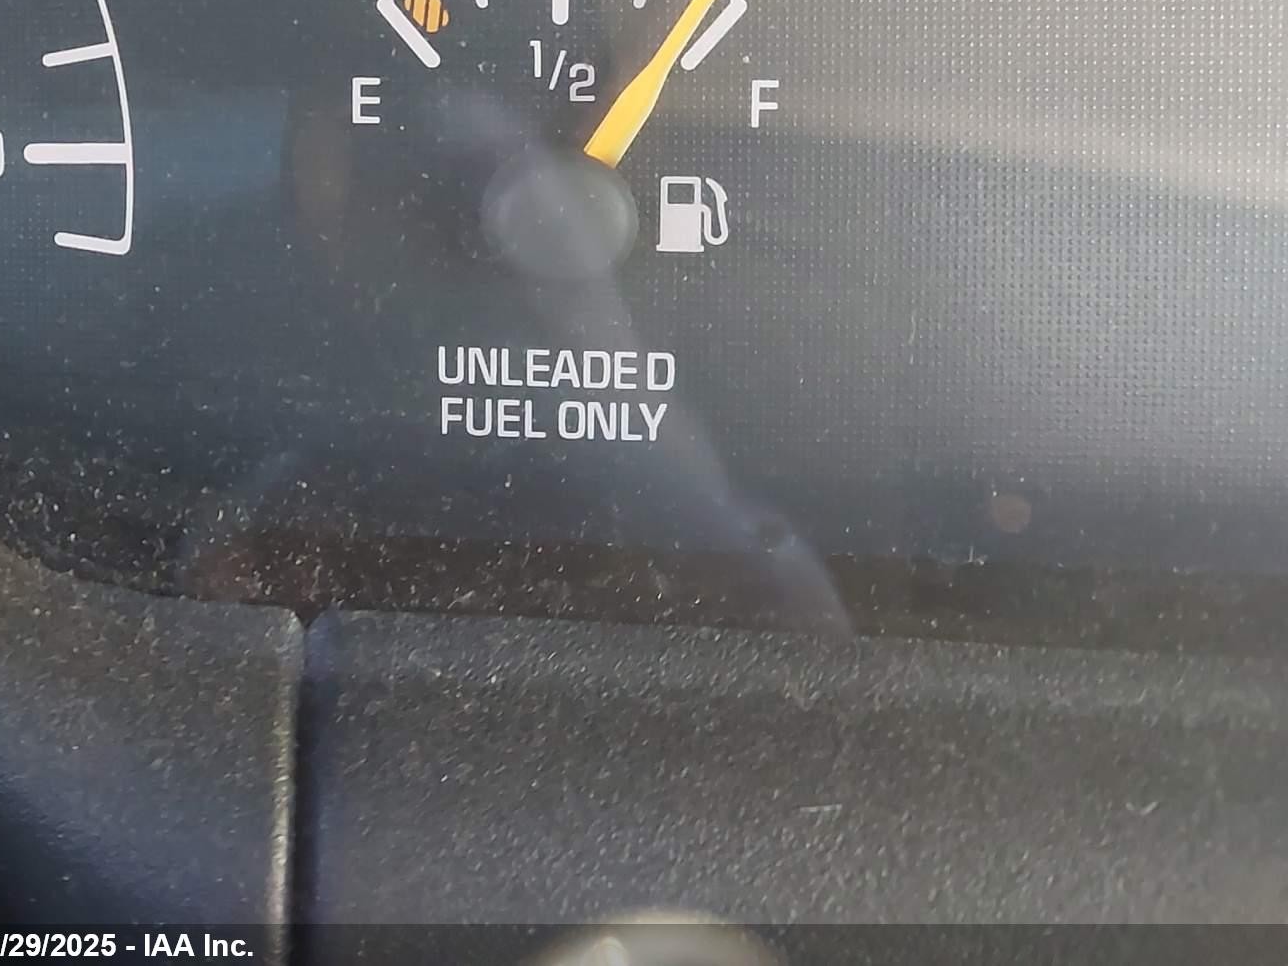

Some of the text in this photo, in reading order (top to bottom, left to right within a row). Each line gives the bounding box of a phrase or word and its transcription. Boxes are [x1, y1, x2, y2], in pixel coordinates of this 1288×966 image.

[530, 40, 596, 102] 1/2
[352, 77, 381, 124] E
[751, 80, 779, 128] F
[439, 346, 675, 391] UNLEADED
[442, 398, 667, 441] FUEL ONLY
